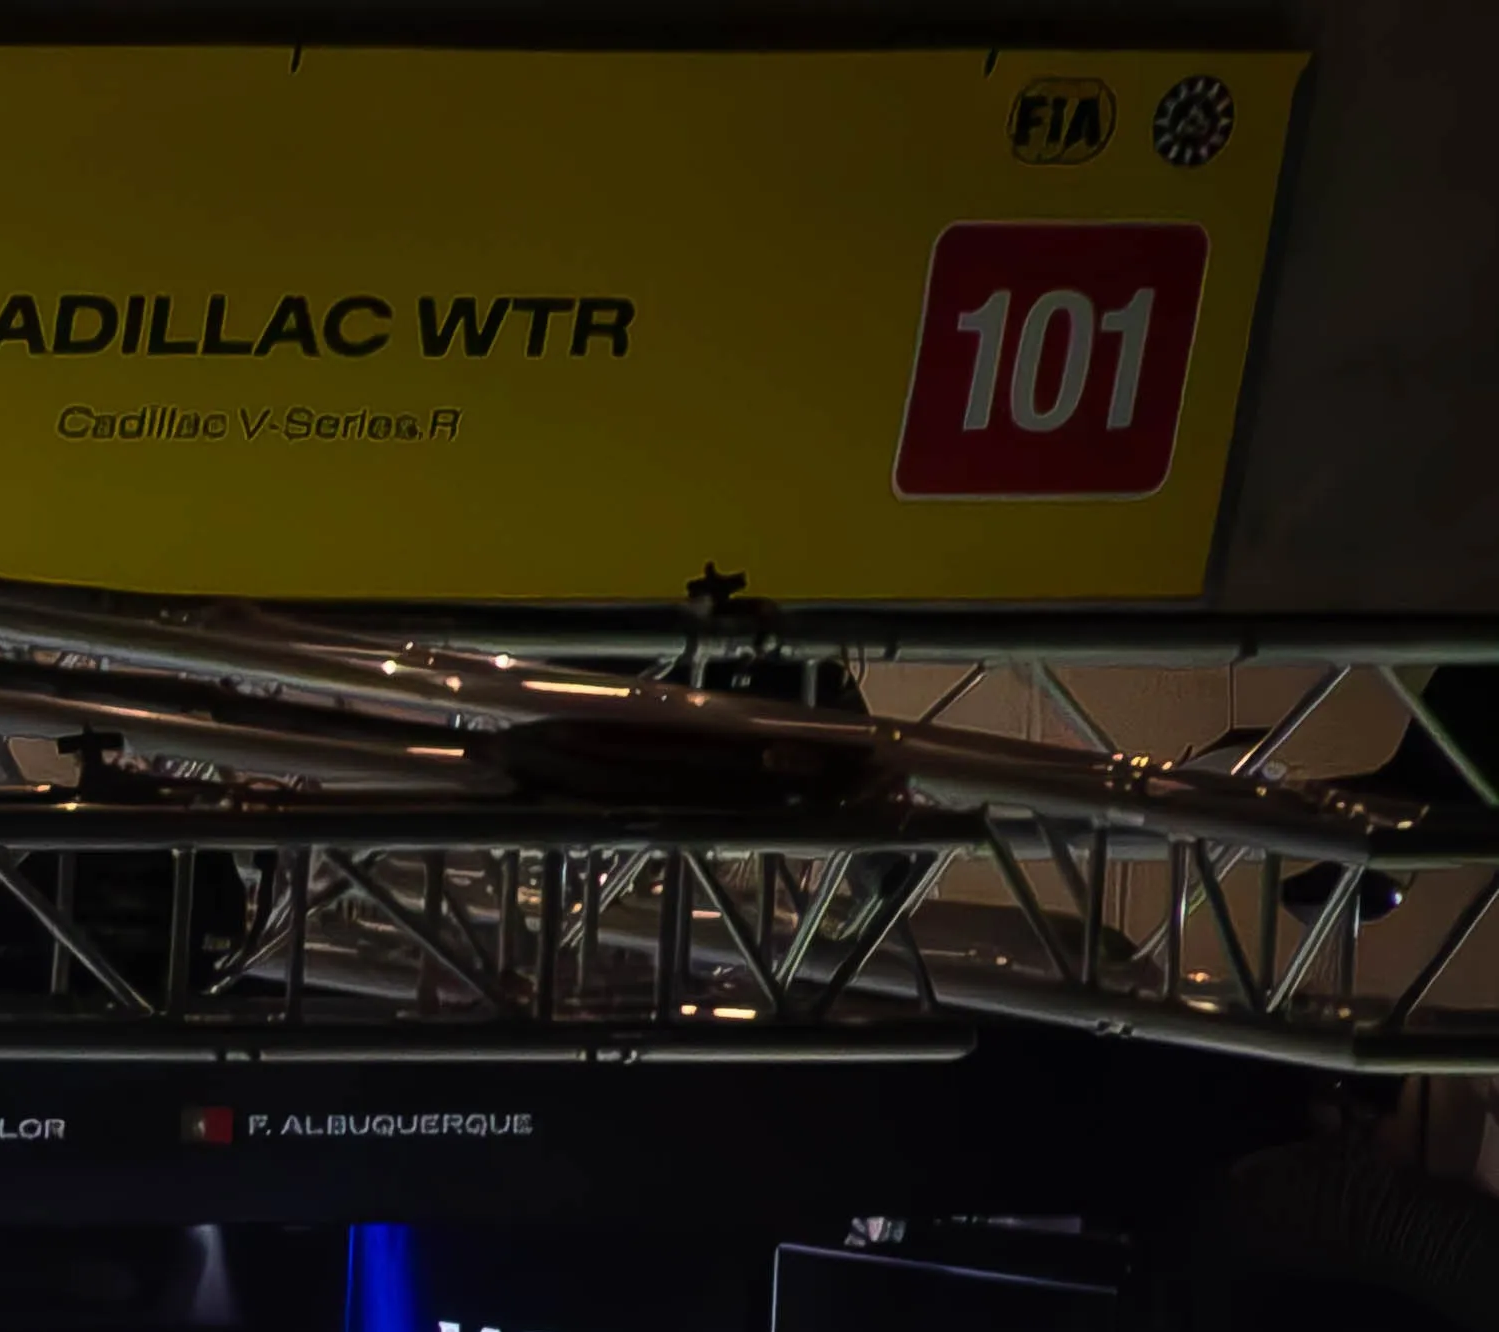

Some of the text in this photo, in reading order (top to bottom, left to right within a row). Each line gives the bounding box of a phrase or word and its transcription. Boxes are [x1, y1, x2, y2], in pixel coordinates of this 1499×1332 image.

[1012, 93, 1106, 147] FIA
[415, 296, 637, 360] WTR
[953, 285, 1159, 434] 101
[55, 404, 463, 443] Cadillac V-Series.R
[247, 1112, 536, 1138] F. ALBUQUERQUE
